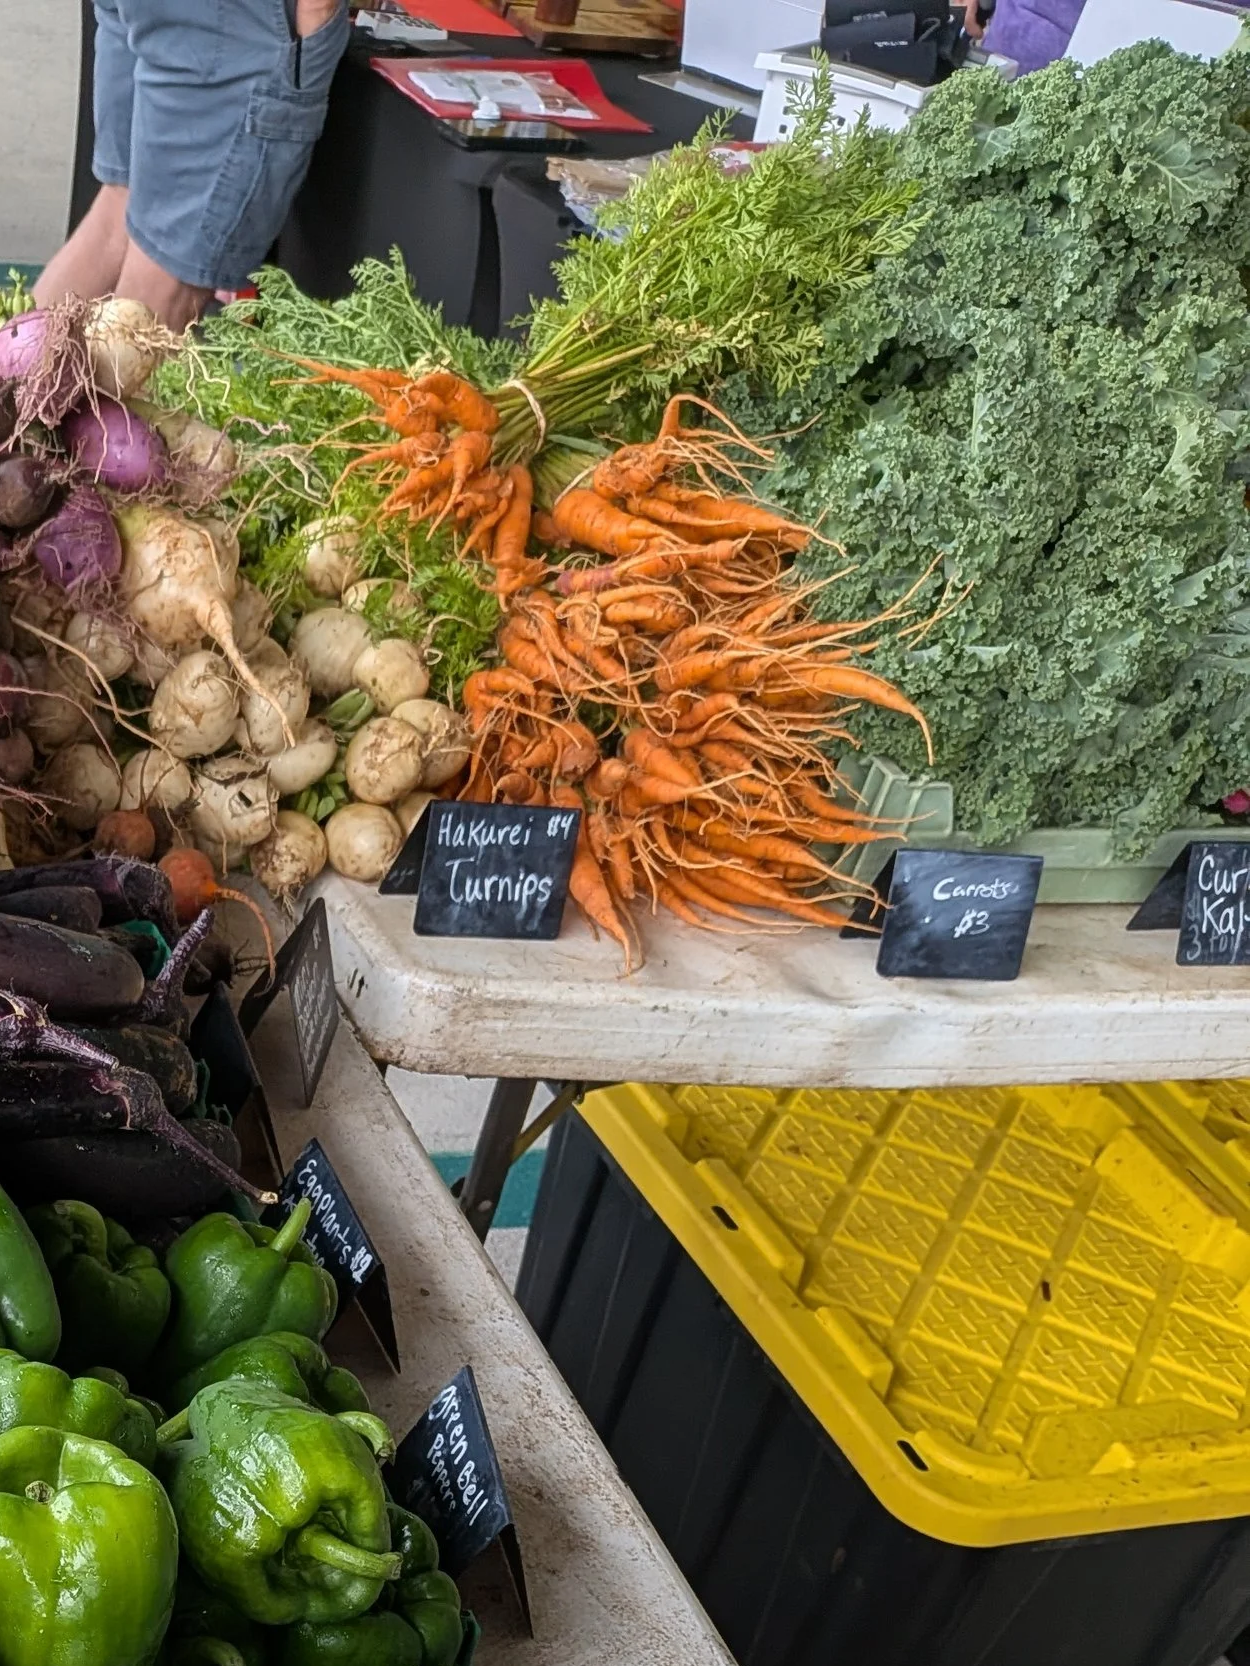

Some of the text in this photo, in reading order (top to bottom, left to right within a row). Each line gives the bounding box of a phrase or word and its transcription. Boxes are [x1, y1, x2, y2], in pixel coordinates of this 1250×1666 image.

[546, 813, 575, 840] $4
[445, 856, 554, 910] Turnips
[933, 877, 1011, 901] Carrots
[1198, 854, 1250, 895] Cur
[1202, 896, 1250, 935] Kal
[456, 1459, 489, 1527] Bell
